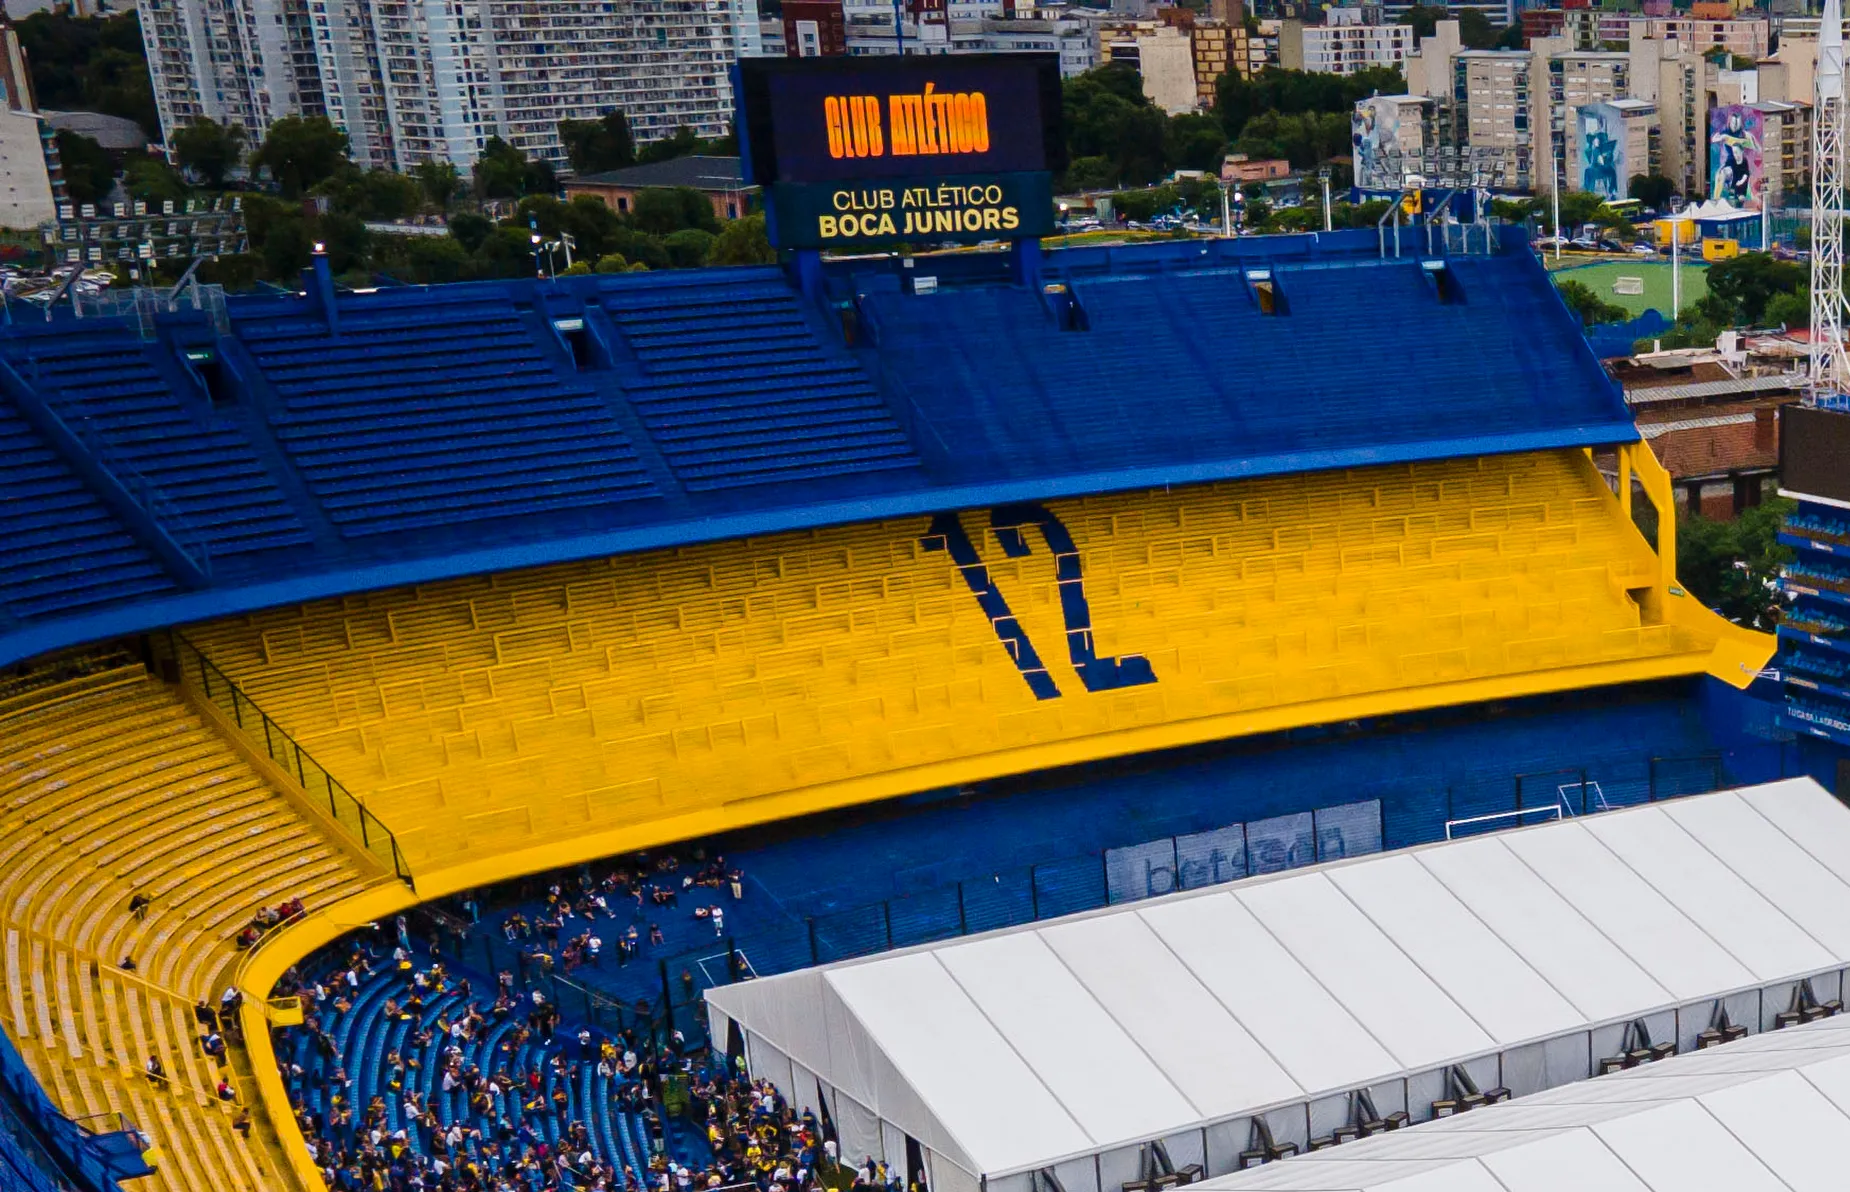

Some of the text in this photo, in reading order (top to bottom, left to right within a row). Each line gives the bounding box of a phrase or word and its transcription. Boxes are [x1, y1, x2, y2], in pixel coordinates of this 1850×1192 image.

[824, 82, 990, 158] CLUB ATLÉTICO
[833, 183, 1002, 210] CLUB ATLÉTICO
[819, 207, 1020, 238] BOCA JUNIORS
